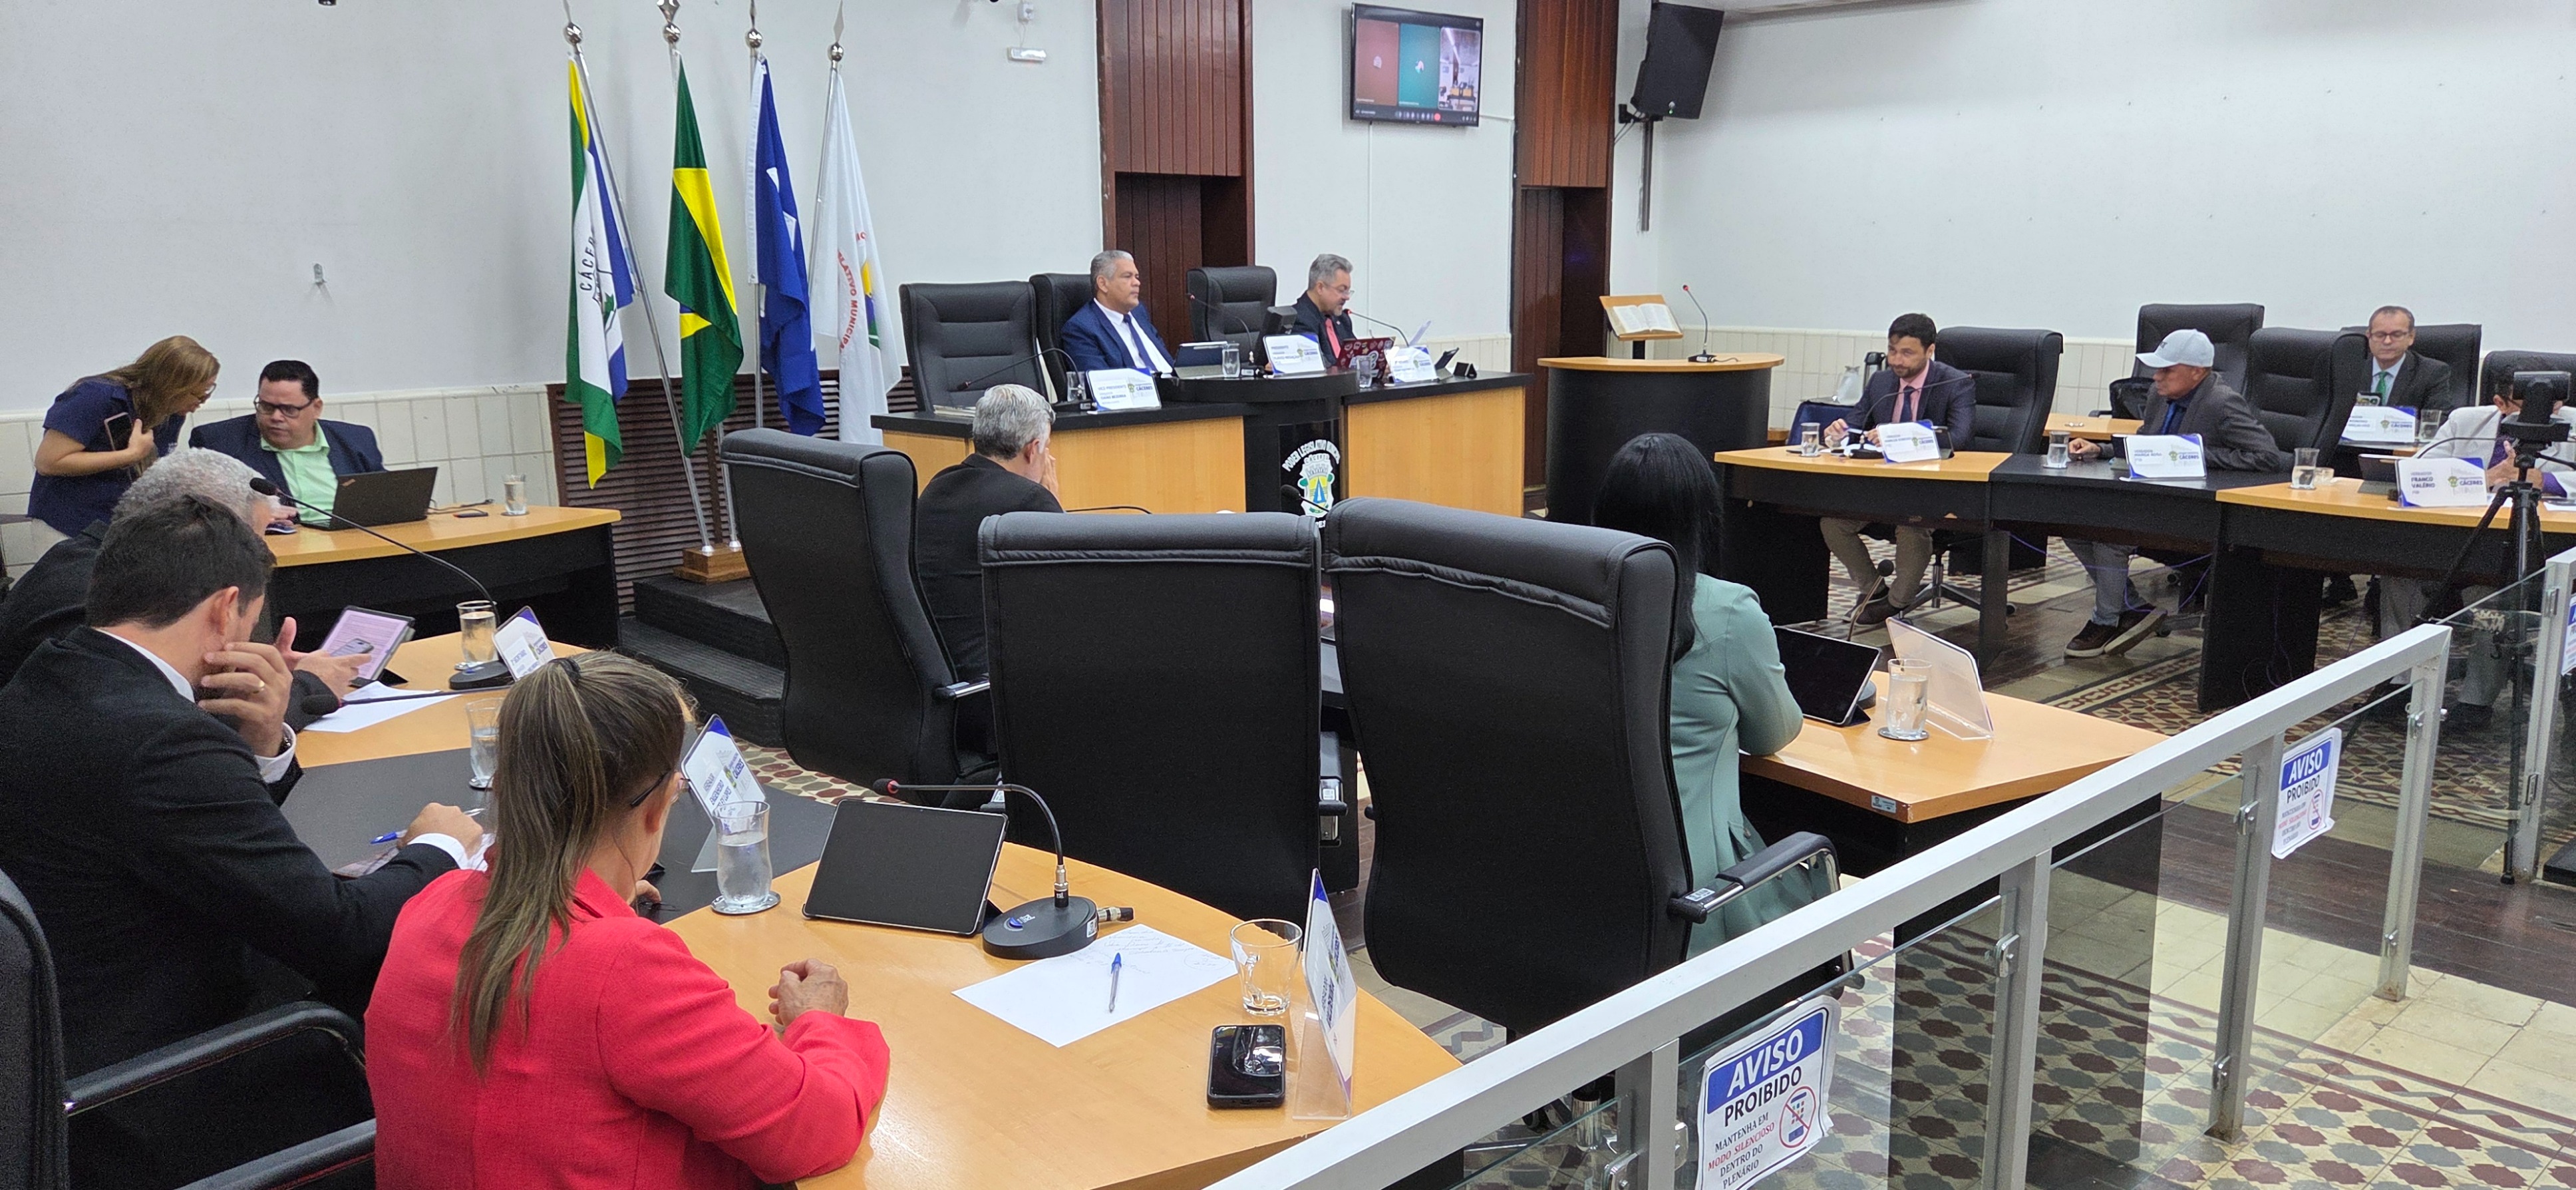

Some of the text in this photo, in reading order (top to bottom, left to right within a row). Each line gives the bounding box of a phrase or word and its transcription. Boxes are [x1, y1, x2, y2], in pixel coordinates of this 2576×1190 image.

[578, 236, 596, 291] CÁCER
[840, 299, 858, 349] MUNICIPA
[2288, 747, 2323, 785] AVISO
[2287, 775, 2321, 804] PROIBIDO
[1726, 1028, 1804, 1097] AVISO
[1724, 1066, 1802, 1127] PROIBIDO
[1707, 1122, 1775, 1171] MODO SILENCIOSO
[1715, 1111, 1769, 1153] MANTENHA EM
[1720, 1143, 1763, 1177] DENTRO DO
[1722, 1159, 1759, 1189] PLENÁRIO
